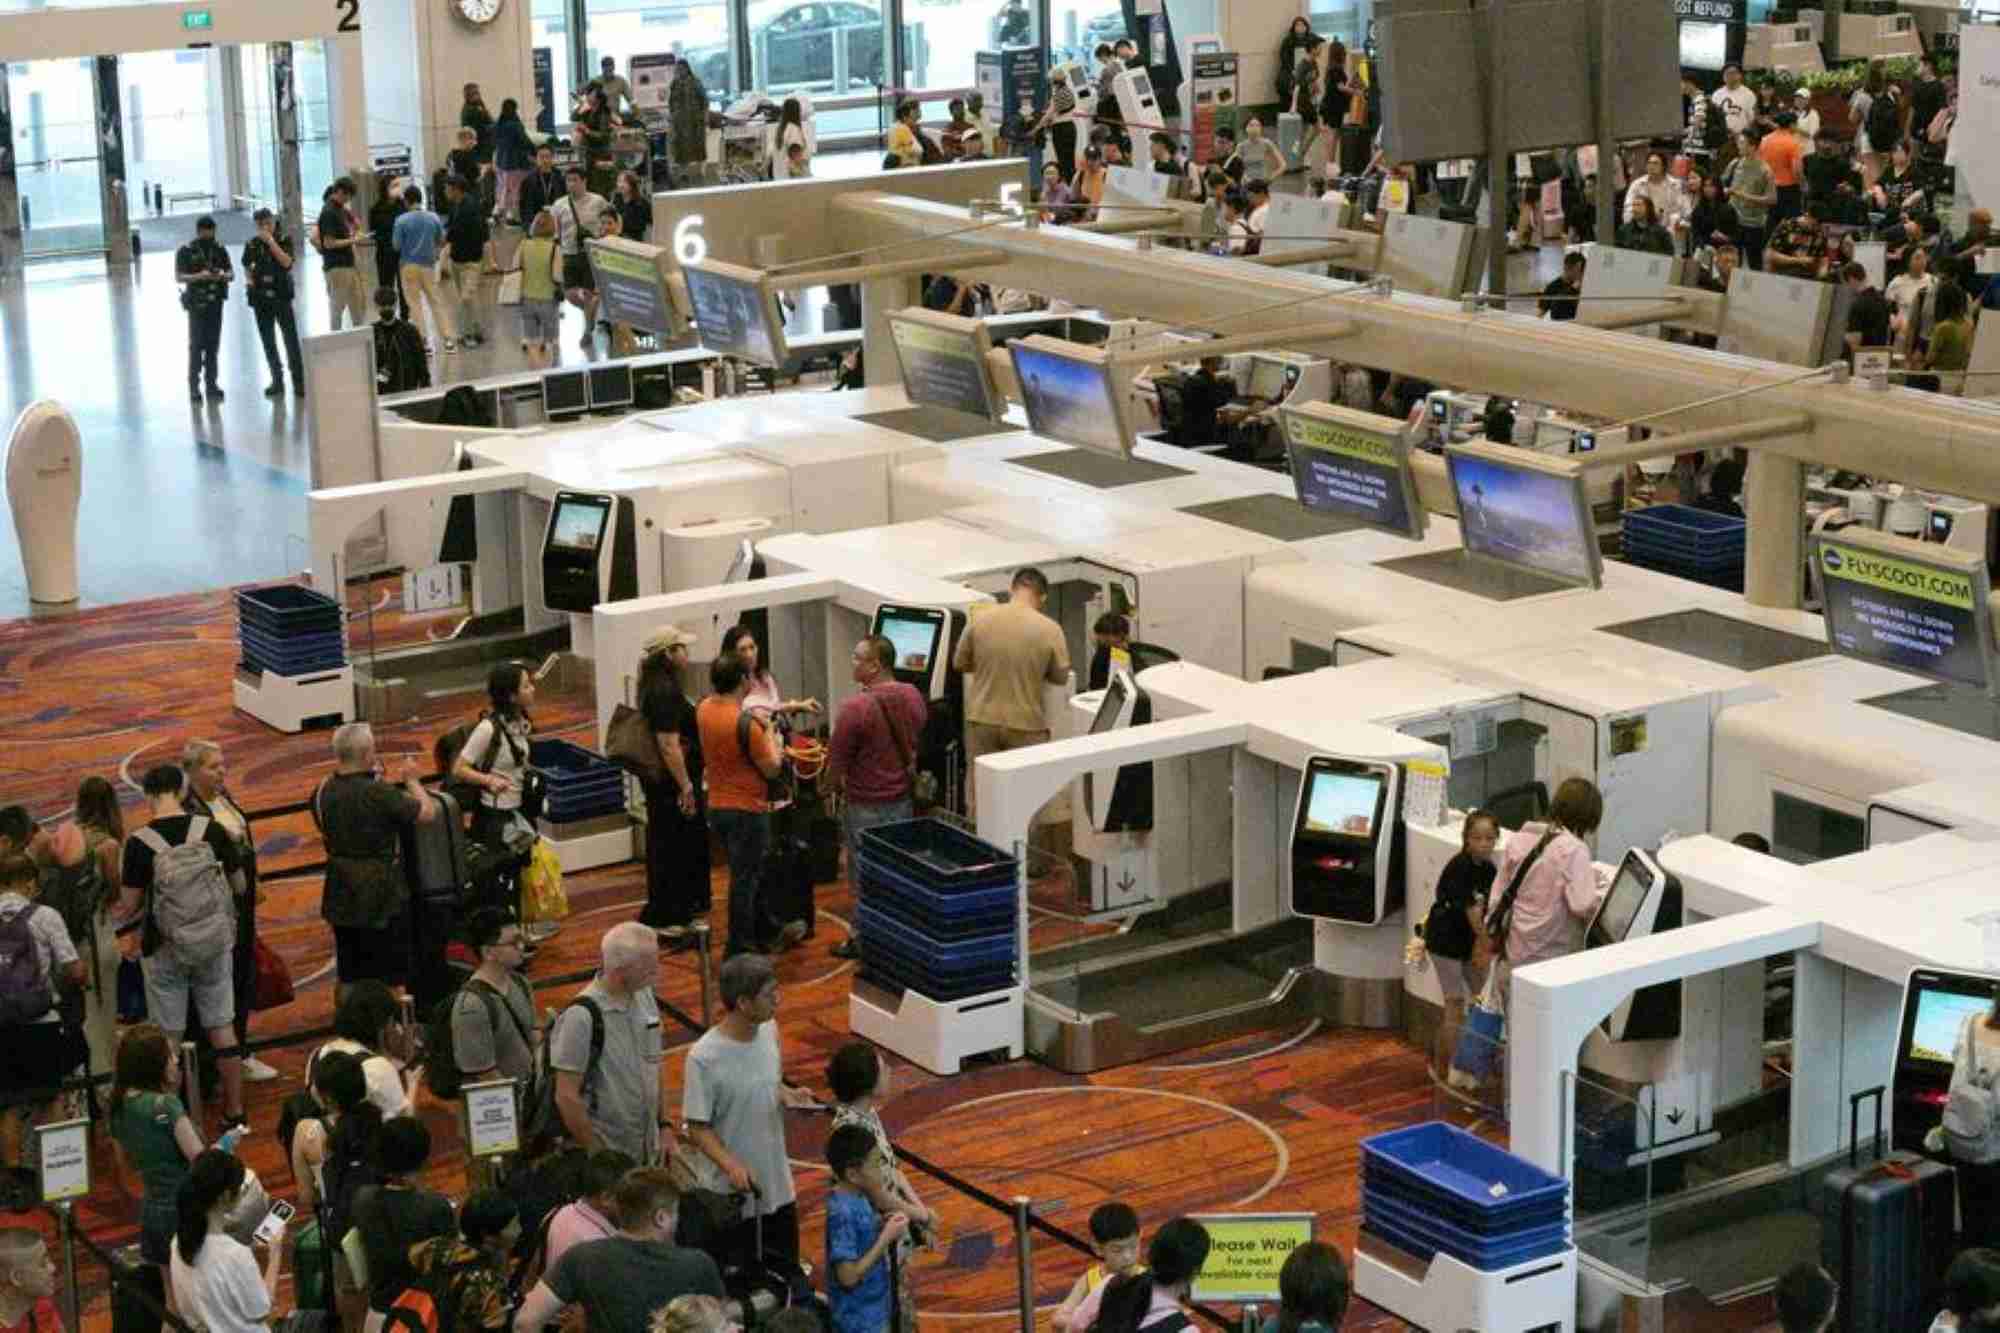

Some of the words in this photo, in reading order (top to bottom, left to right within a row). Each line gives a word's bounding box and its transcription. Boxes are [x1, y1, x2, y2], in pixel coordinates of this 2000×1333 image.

[336, 0, 360, 32] 2
[1694, 1, 1734, 18] REFUND
[1000, 183, 1024, 217] 5
[673, 214, 707, 266] 6
[1847, 557, 1969, 599] FLYSCOOT.COM
[1212, 1237, 1256, 1251] lease
[1261, 1237, 1297, 1251] Wait
